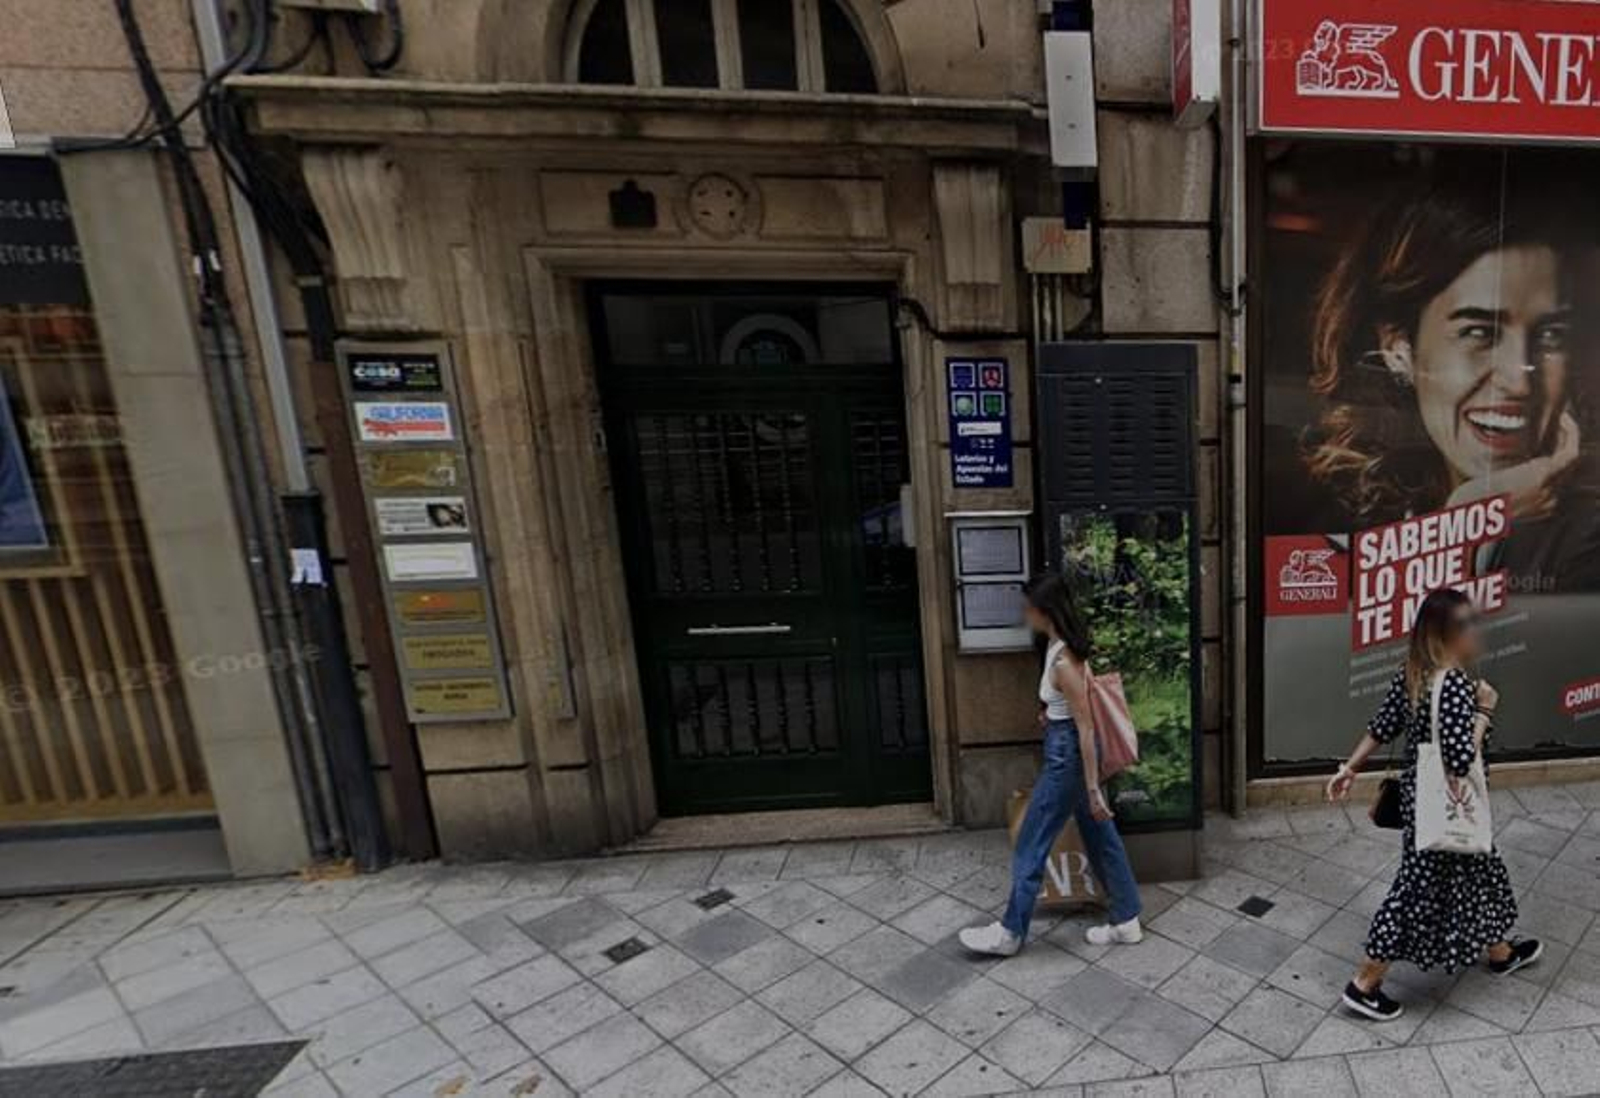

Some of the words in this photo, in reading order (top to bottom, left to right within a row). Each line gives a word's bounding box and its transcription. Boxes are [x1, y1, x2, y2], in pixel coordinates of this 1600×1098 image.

[1408, 26, 1600, 107] GENE
[1358, 498, 1506, 570] SABEMOS
[1280, 587, 1338, 601] GENERALI
[1358, 565, 1396, 609] LO
[1405, 548, 1463, 597] QUE
[1357, 602, 1393, 645] TE
